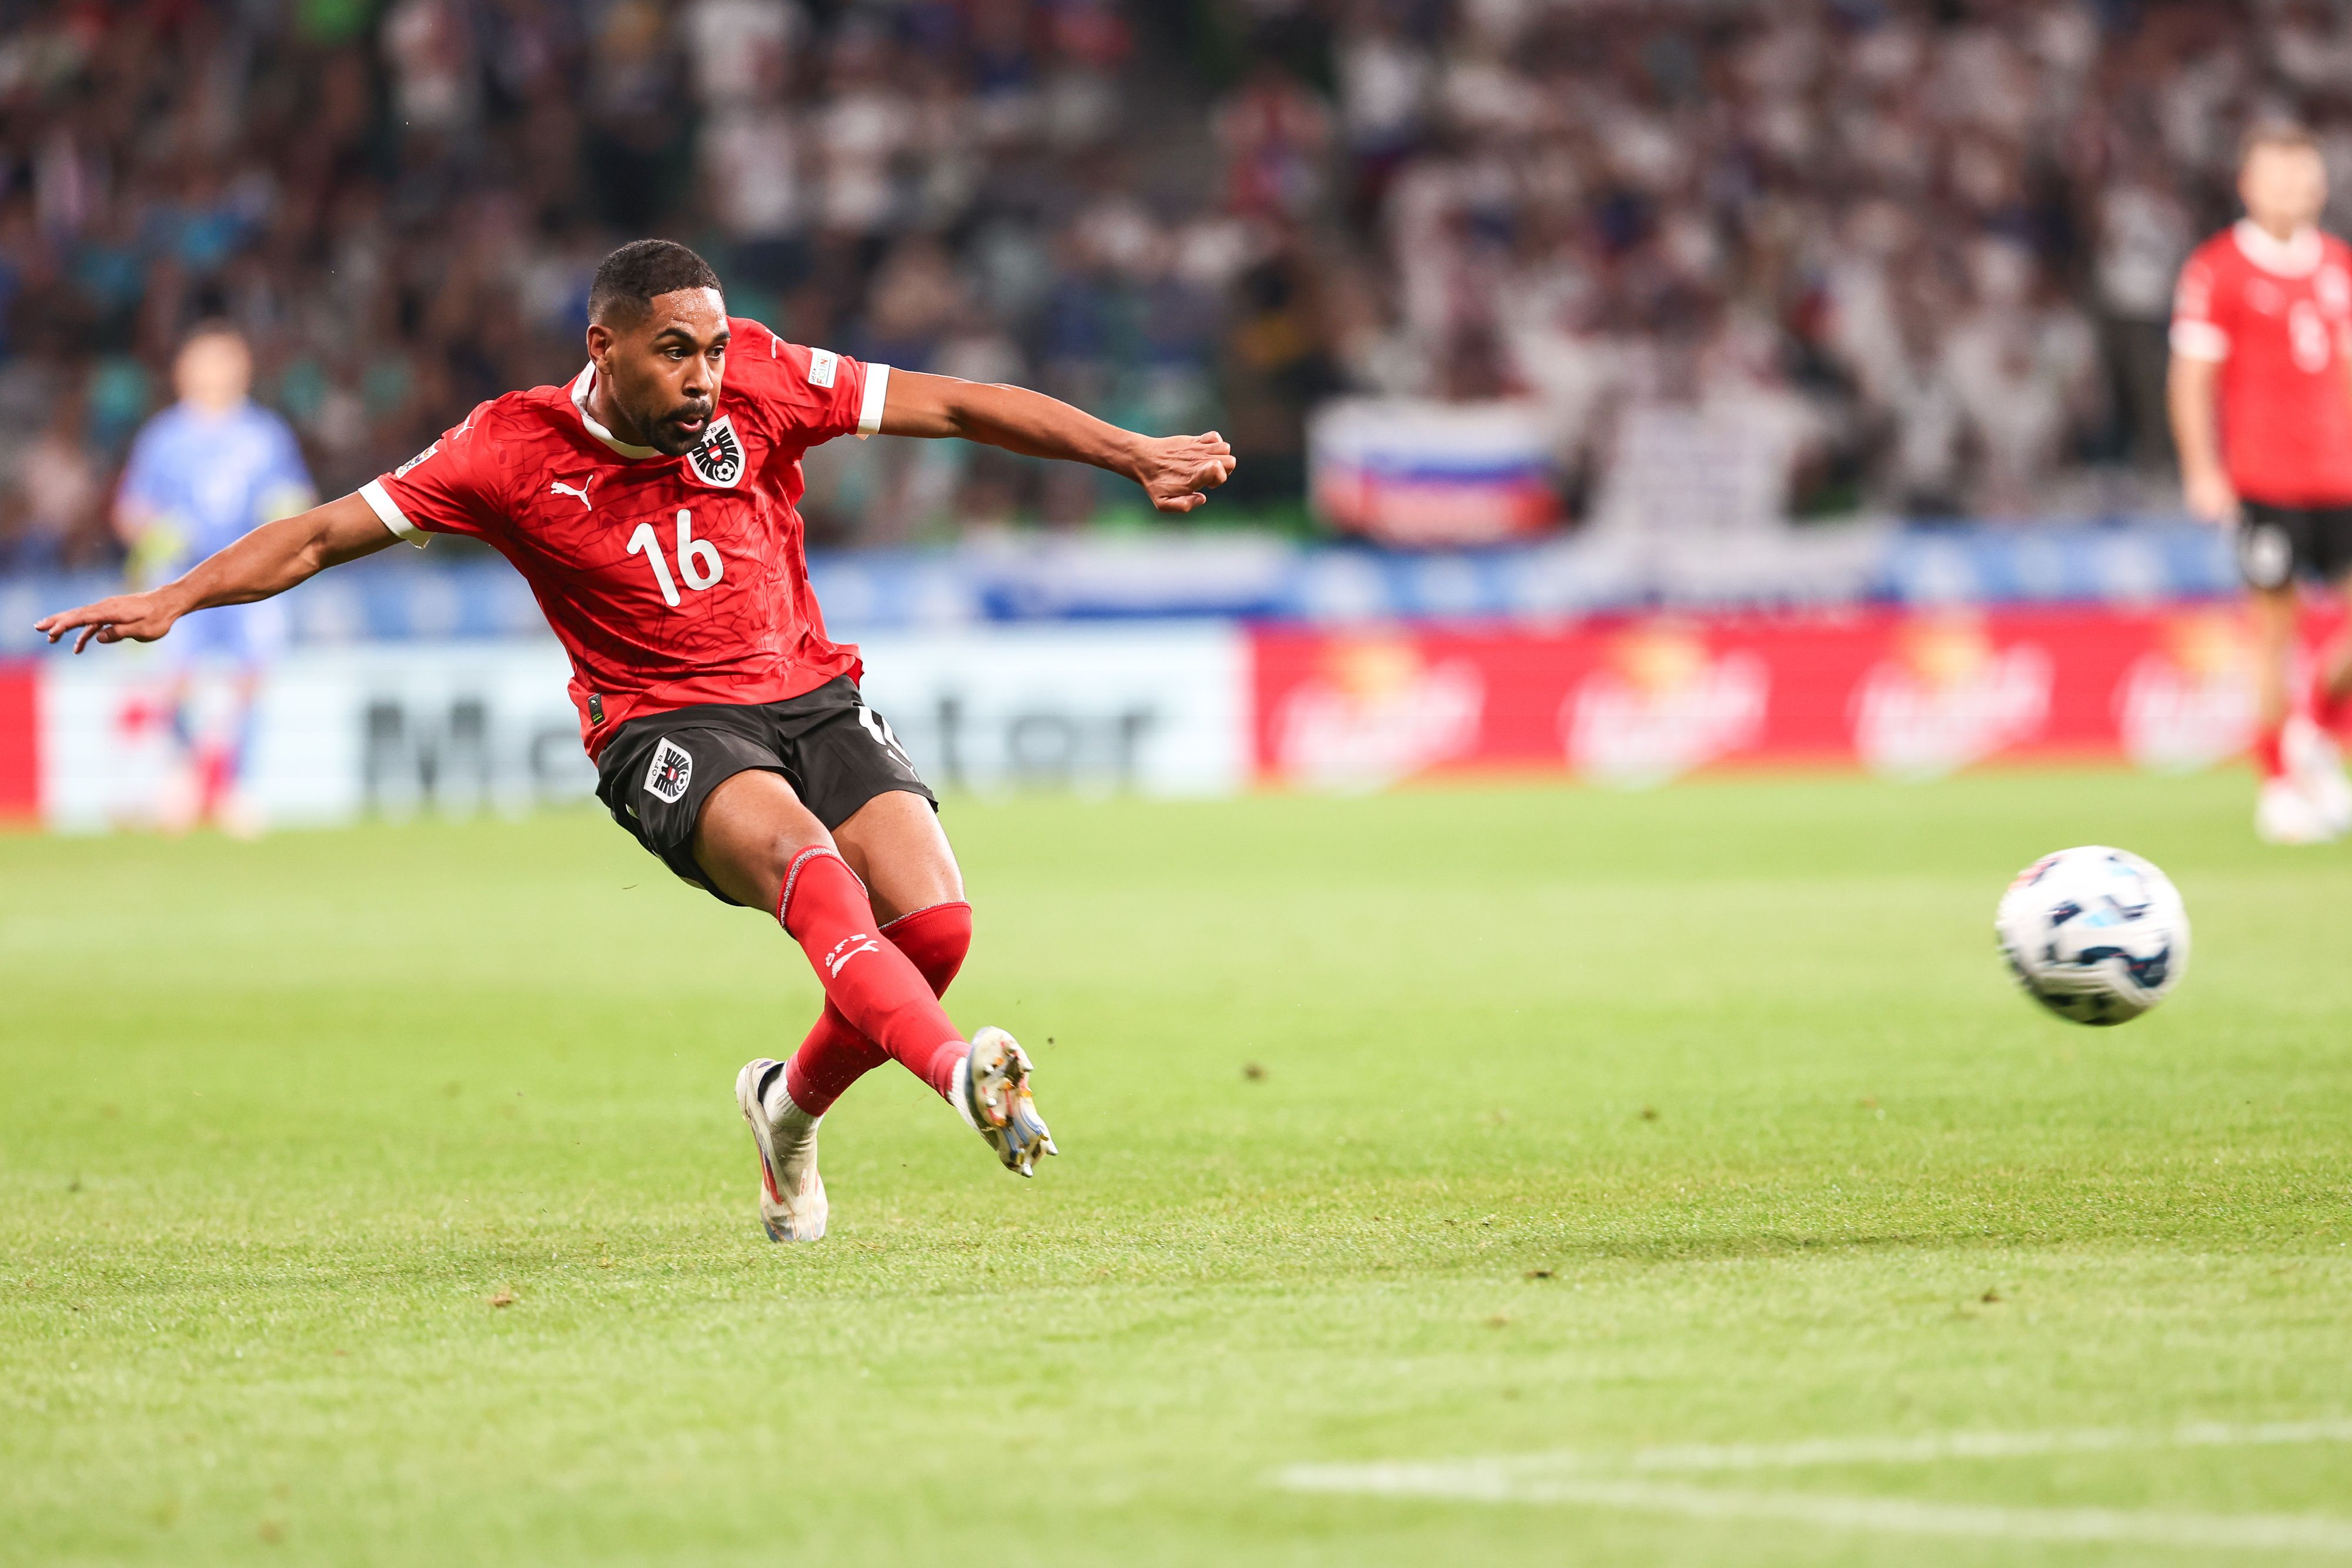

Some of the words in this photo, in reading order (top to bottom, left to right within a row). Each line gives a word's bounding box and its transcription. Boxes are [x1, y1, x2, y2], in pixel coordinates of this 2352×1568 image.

[817, 357, 828, 385] FOUN
[704, 427, 717, 437] FB
[626, 509, 724, 607] 16
